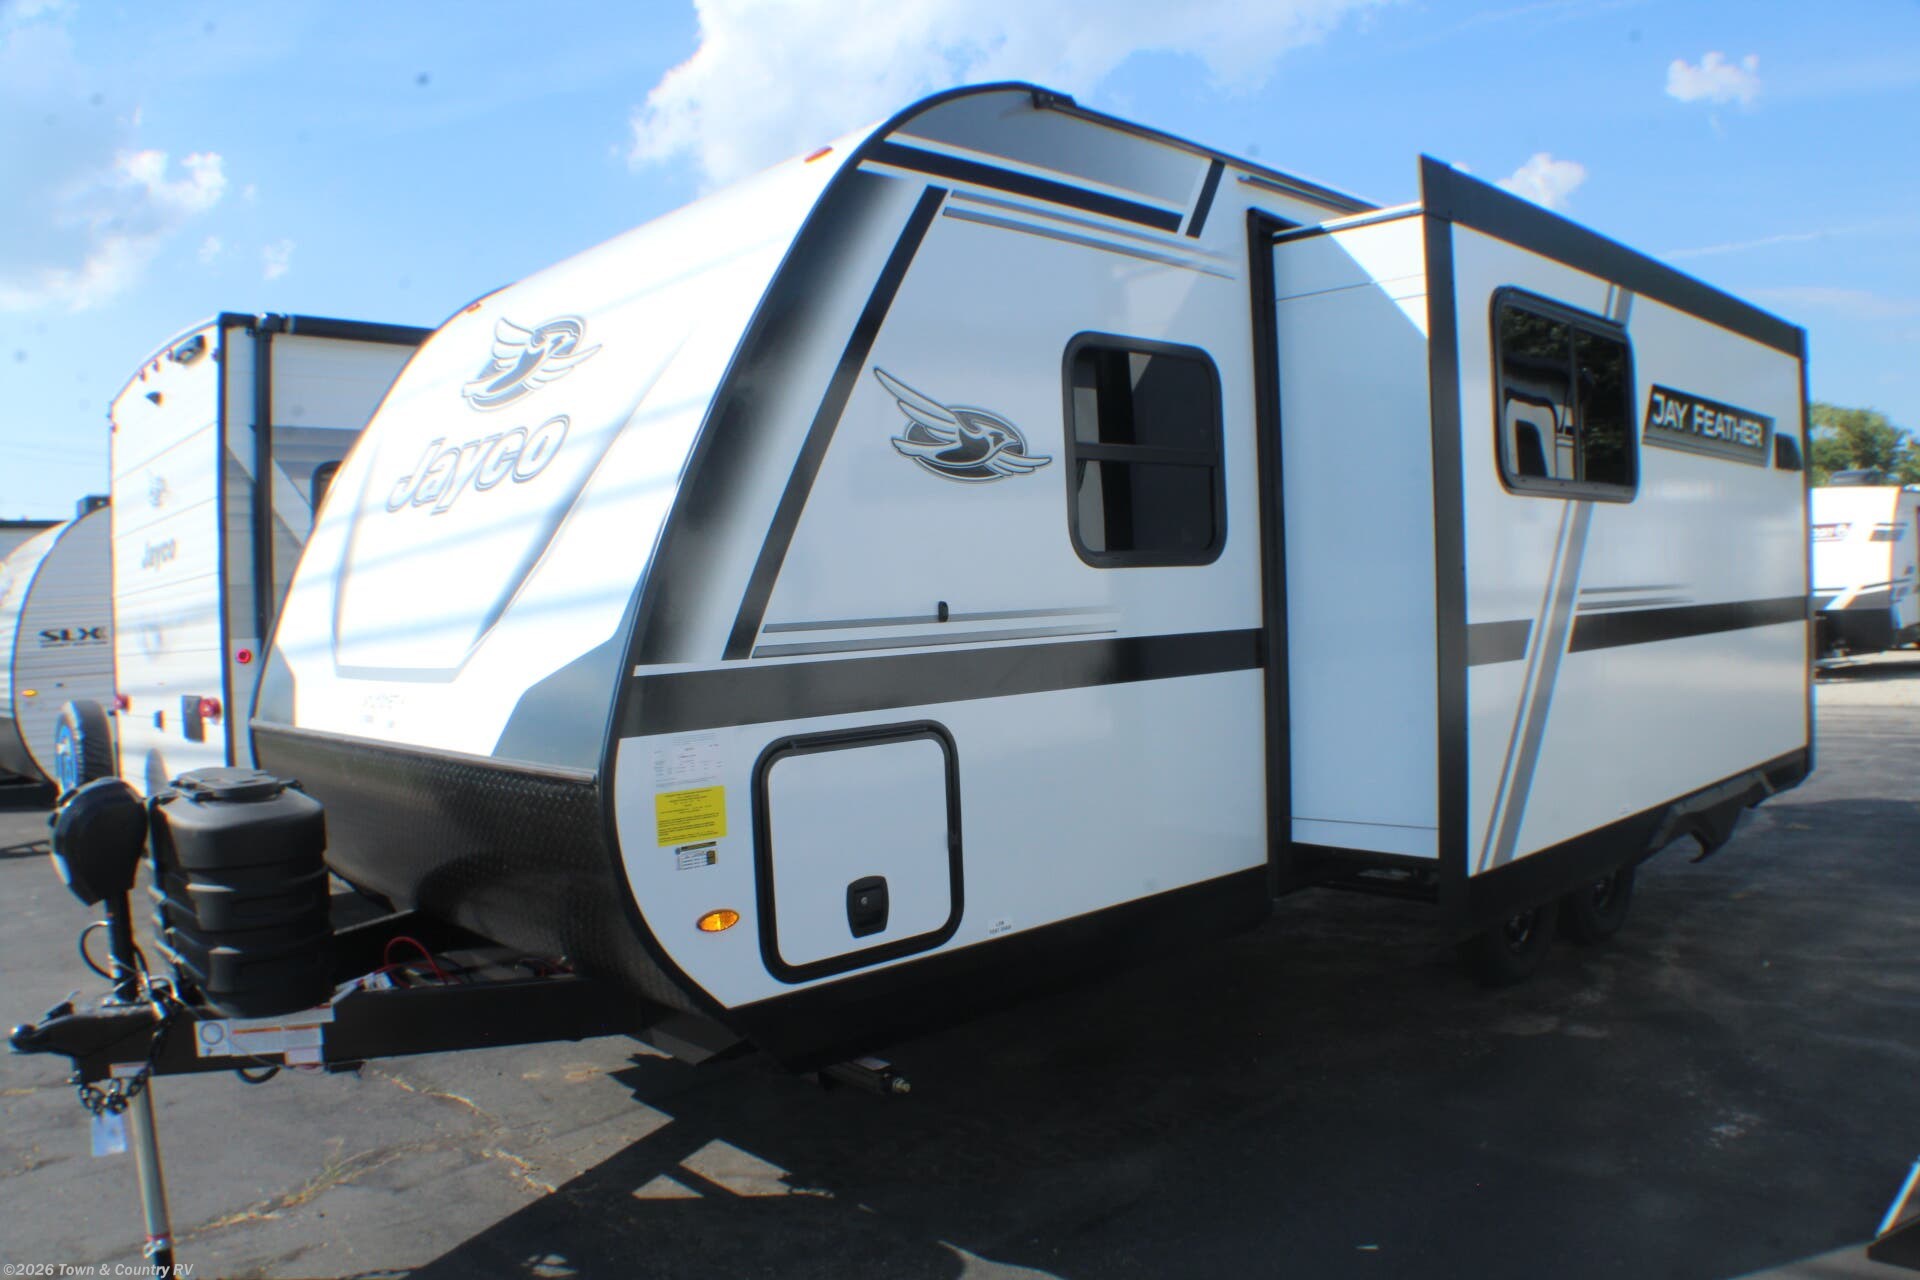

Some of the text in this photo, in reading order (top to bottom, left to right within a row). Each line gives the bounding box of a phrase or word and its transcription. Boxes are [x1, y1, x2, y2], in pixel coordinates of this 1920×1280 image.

[1652, 393, 1763, 446] JAY FEATHER
[385, 414, 570, 516] Jayco
[38, 627, 107, 641] SLX
